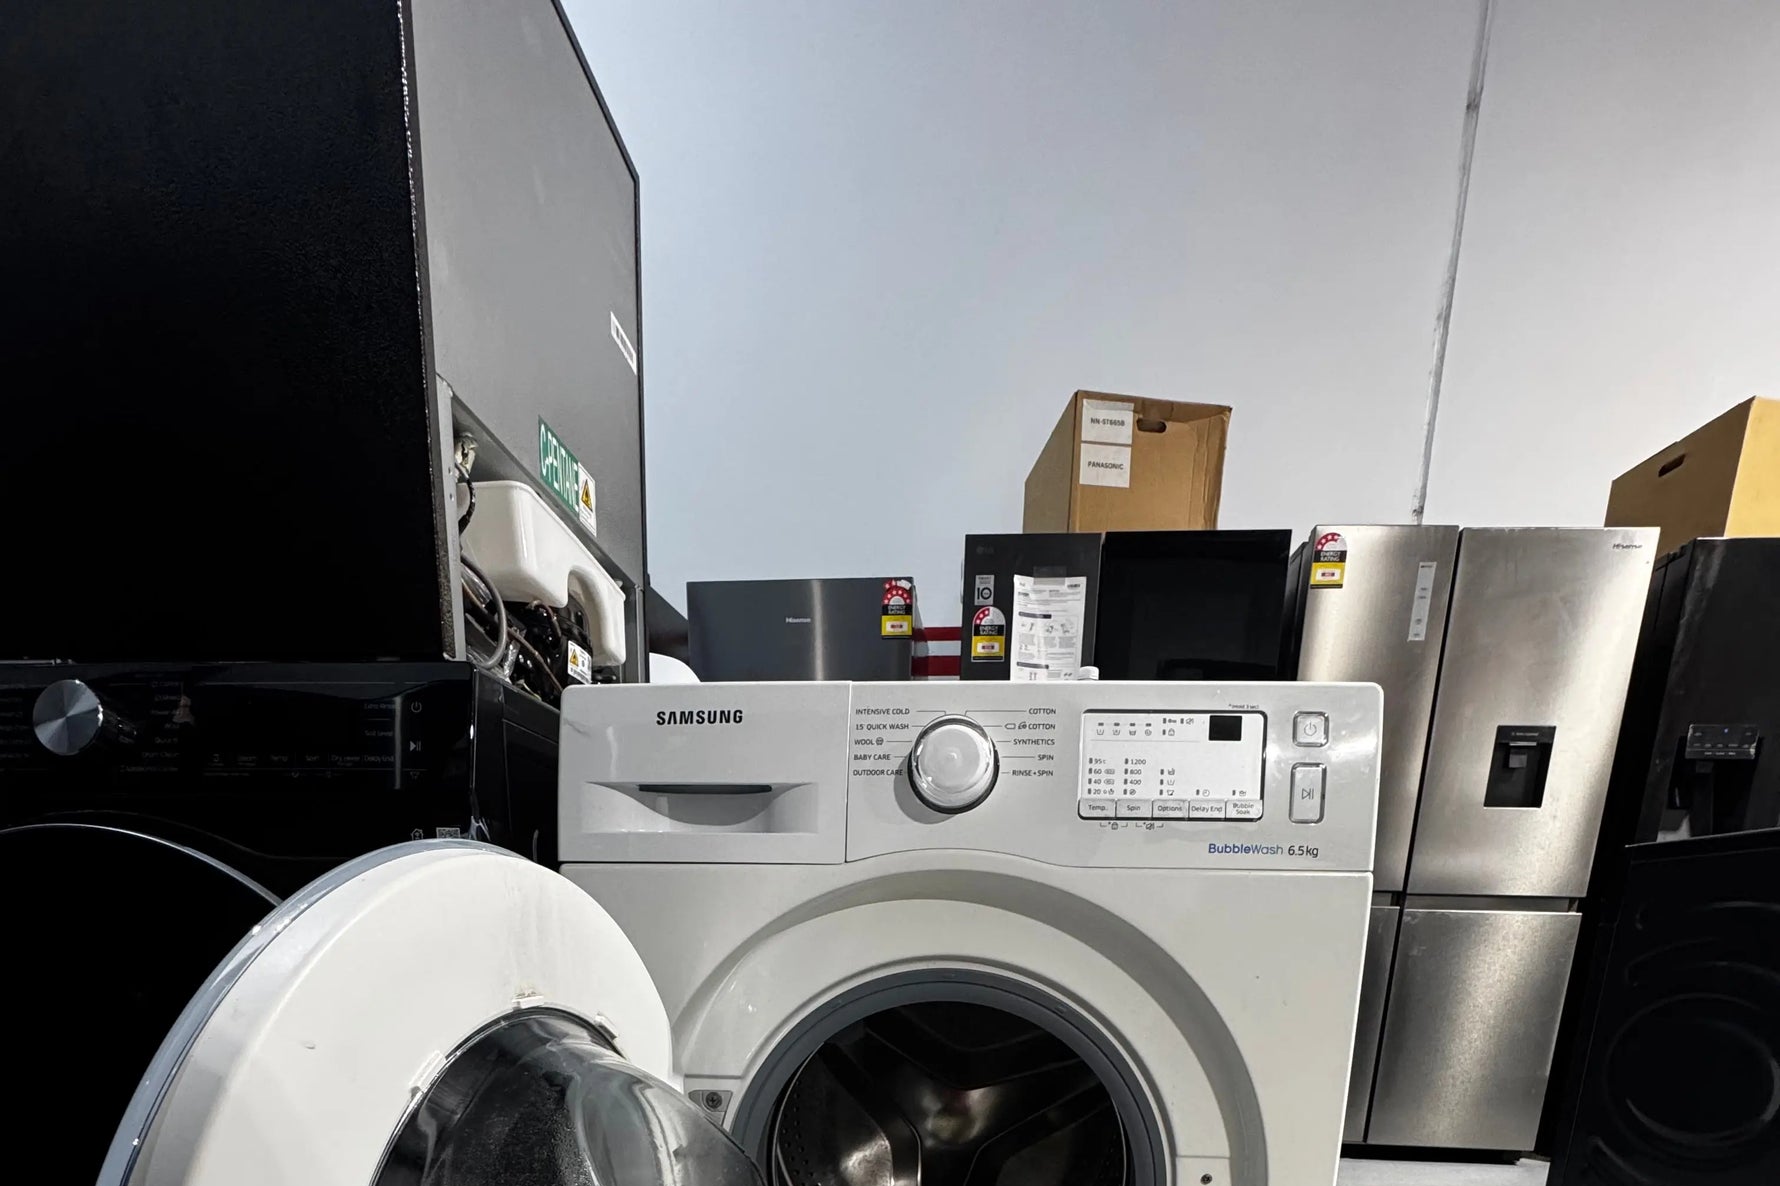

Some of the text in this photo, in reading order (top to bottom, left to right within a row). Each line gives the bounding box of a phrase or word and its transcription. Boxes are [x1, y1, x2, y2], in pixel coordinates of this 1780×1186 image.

[1087, 460, 1124, 470] PANASONIC
[655, 709, 743, 726] SAMSUNG
[866, 723, 887, 731] QUICK
[854, 738, 875, 746] WOOL
[1012, 738, 1055, 746] SYNTHETICS
[1126, 804, 1141, 812] Spin
[1191, 805, 1209, 813] Delay
[1207, 843, 1284, 855] BubbleWash
